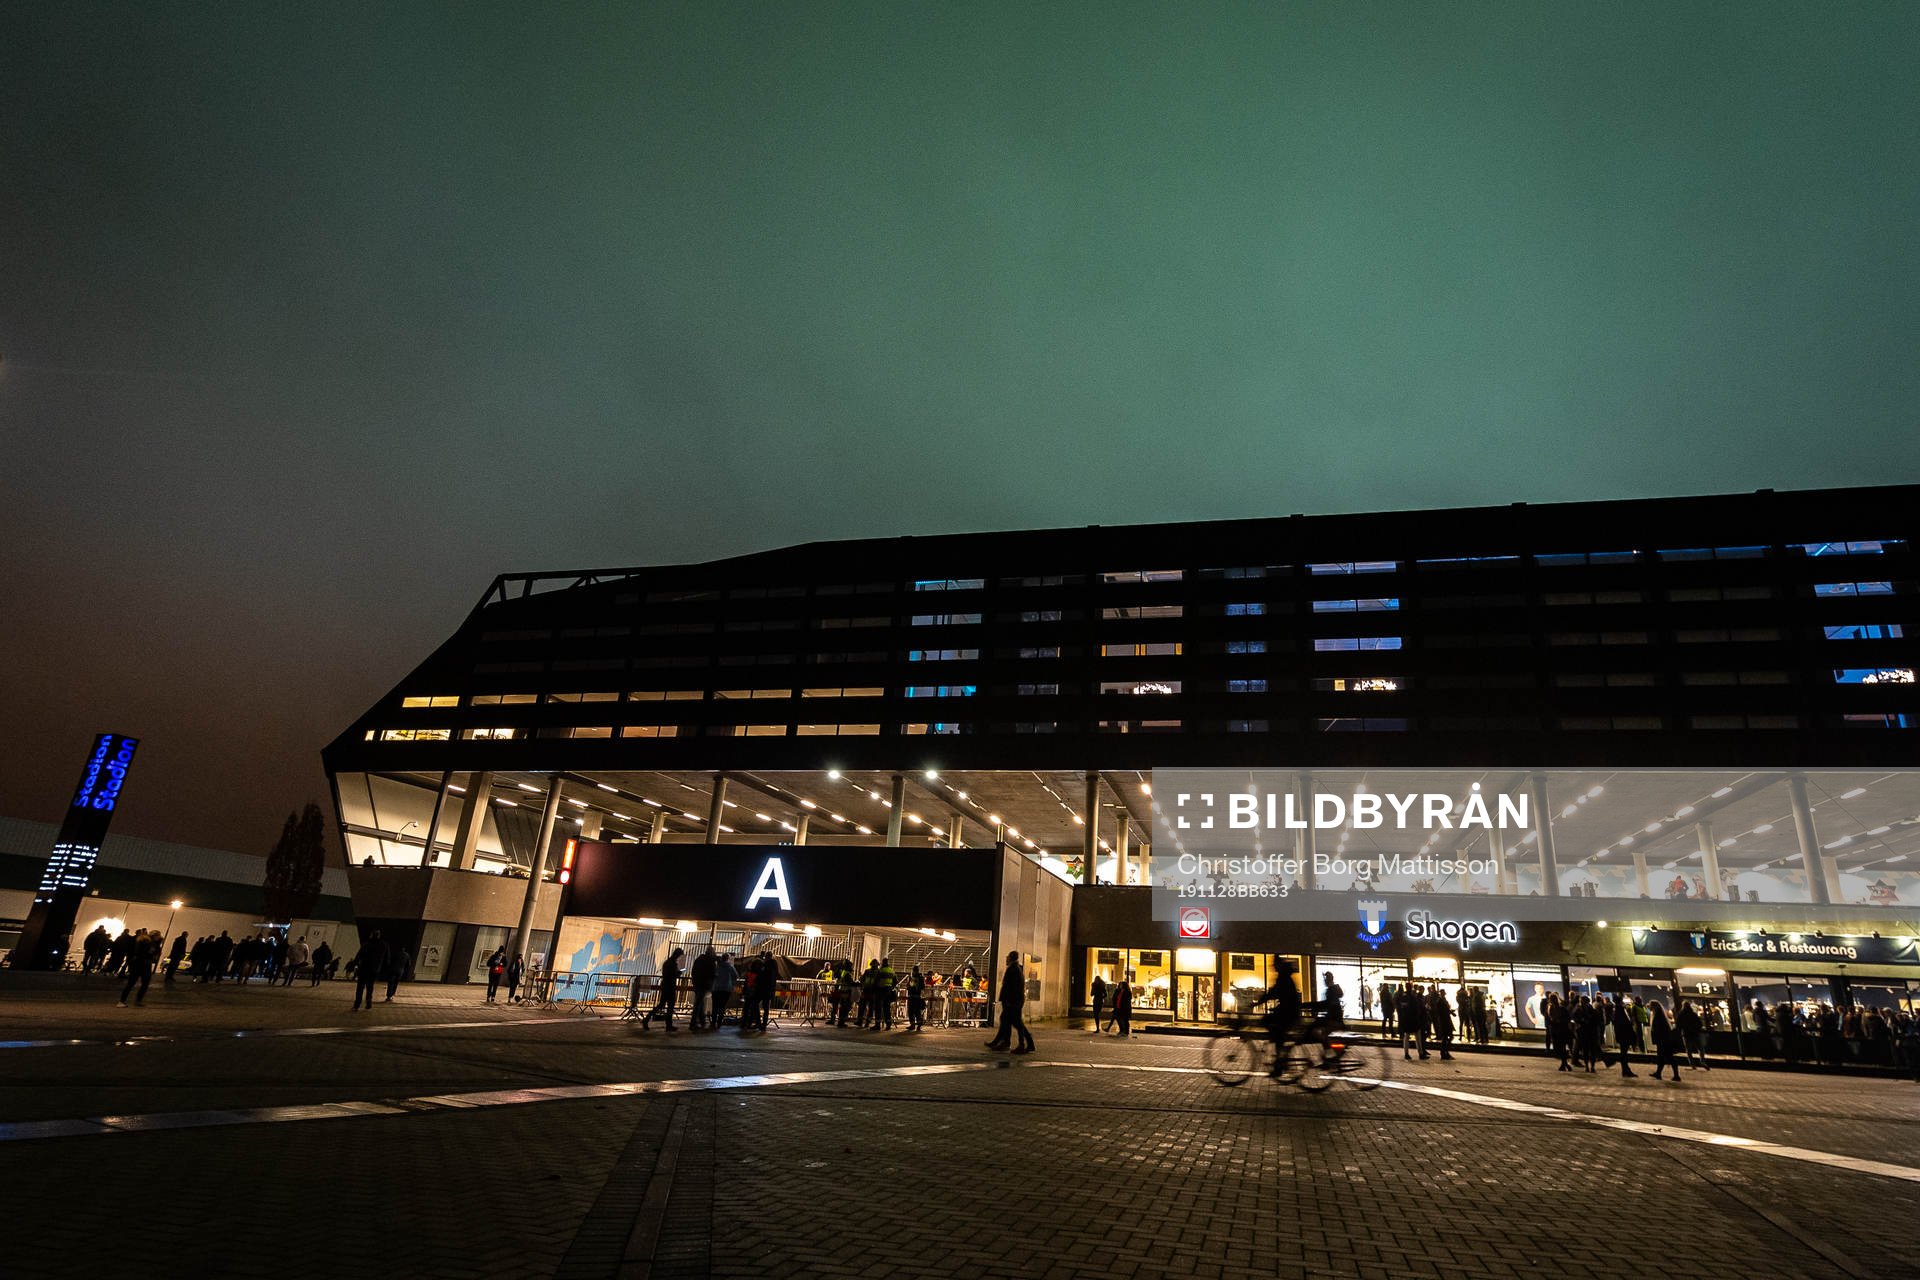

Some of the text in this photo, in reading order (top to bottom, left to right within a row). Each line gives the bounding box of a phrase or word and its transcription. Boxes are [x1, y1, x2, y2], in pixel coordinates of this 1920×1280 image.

[74, 734, 113, 807] Stadion
[92, 738, 137, 811] Stadion
[745, 857, 792, 911] A
[1406, 909, 1518, 950] Shopen
[1710, 938, 1738, 951] Erics
[1766, 940, 1778, 953] &
[1780, 941, 1858, 959] Restaurang
[1695, 982, 1712, 995] 13
